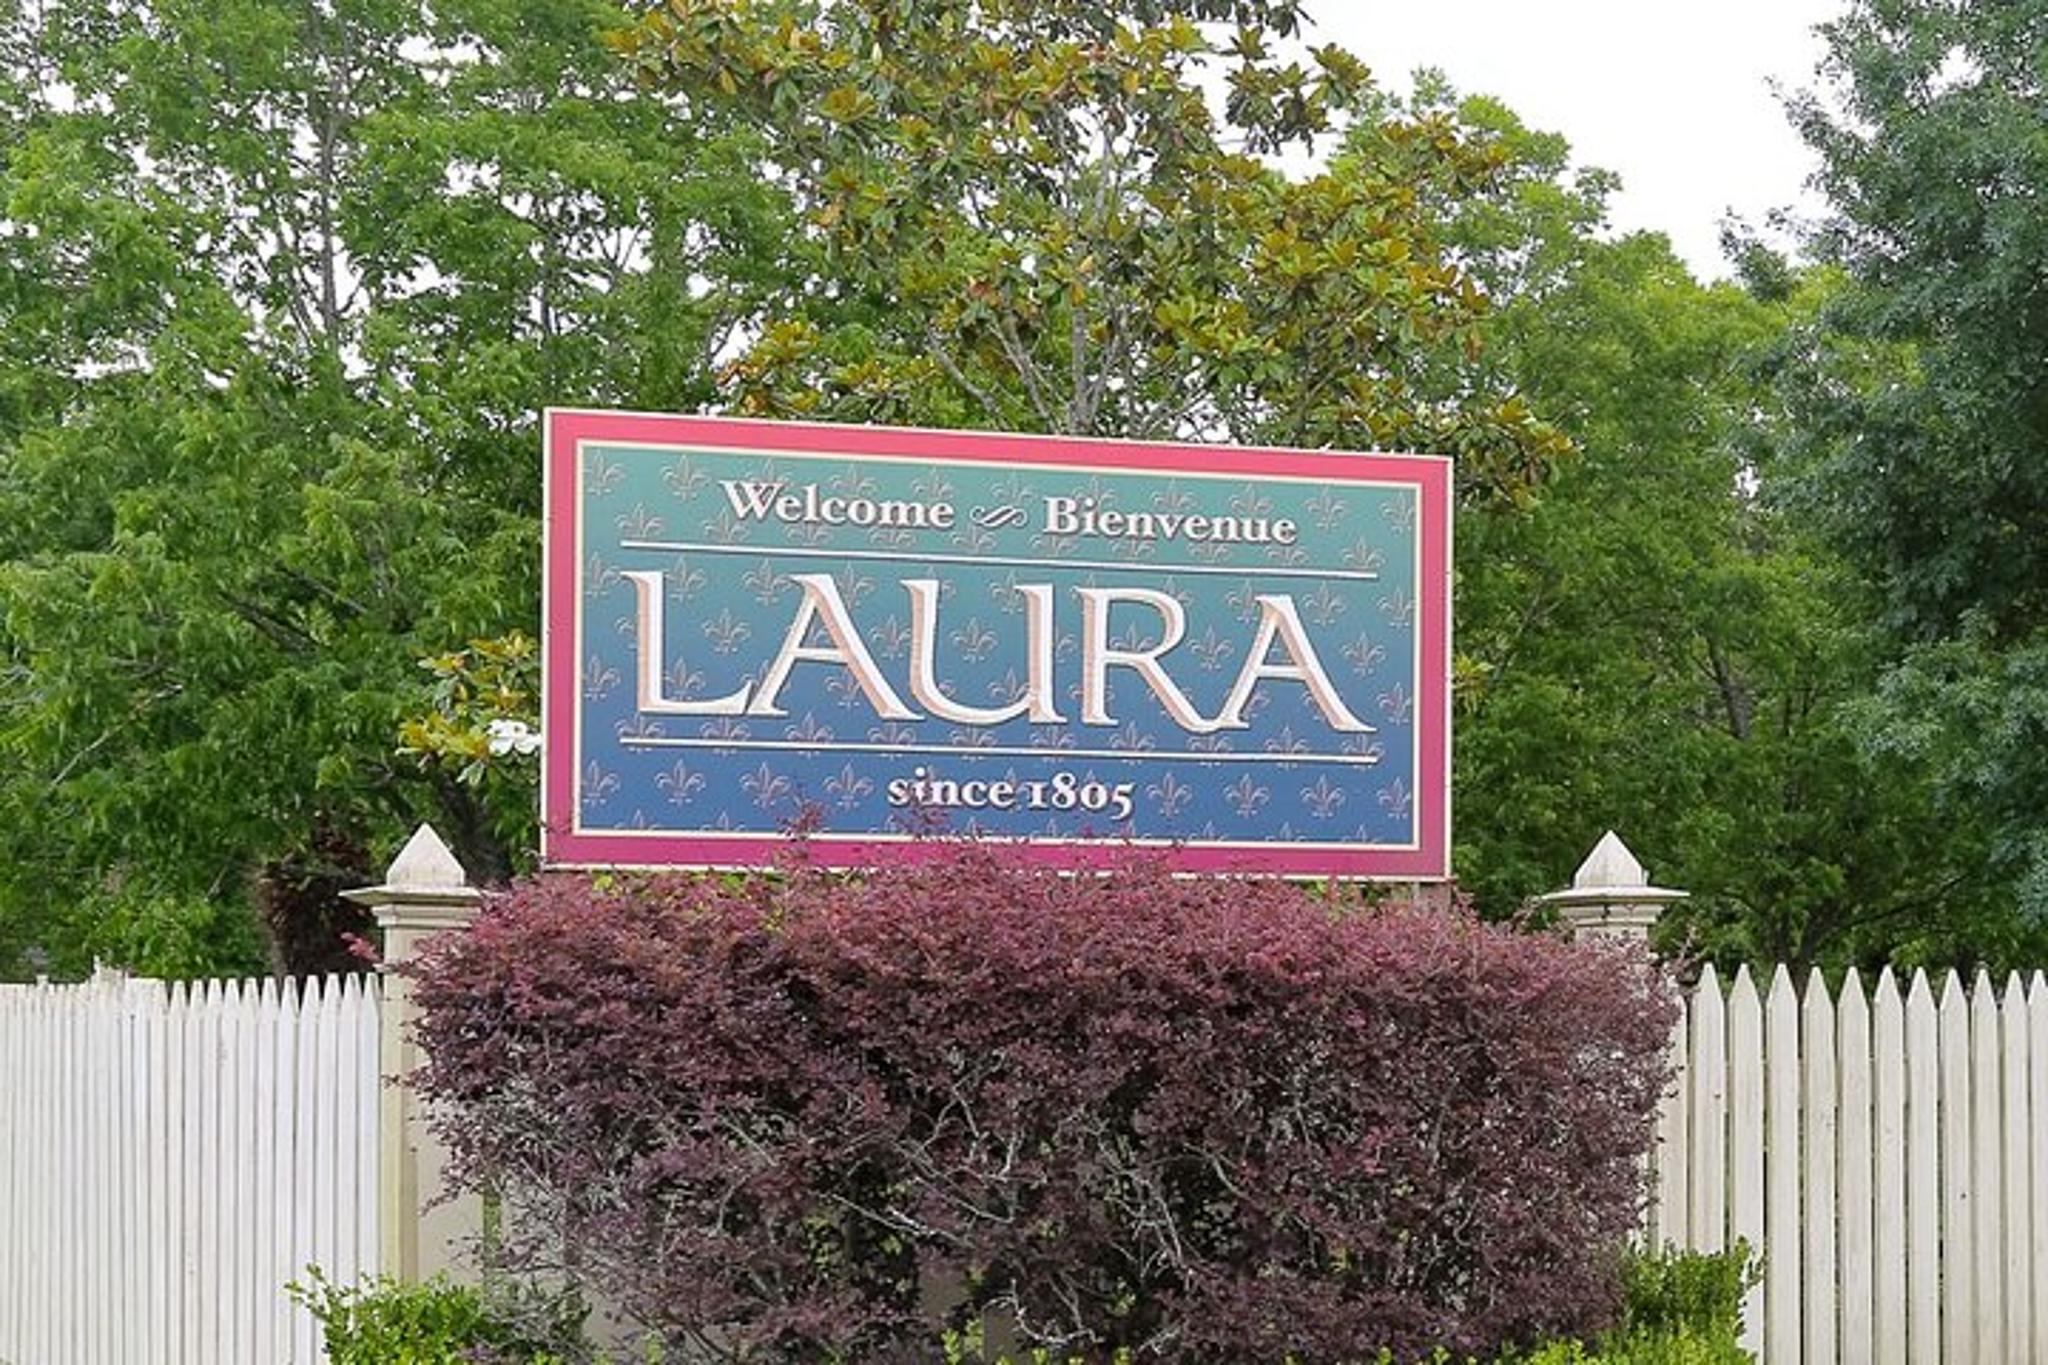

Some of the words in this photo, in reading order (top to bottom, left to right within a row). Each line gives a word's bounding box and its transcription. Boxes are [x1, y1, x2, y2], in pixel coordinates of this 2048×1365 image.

[719, 478, 955, 530] Welcome
[1044, 496, 1298, 546] Bienvenue
[620, 569, 1377, 735] LAURA
[887, 767, 1016, 809] since
[1025, 772, 1135, 820] 1805
